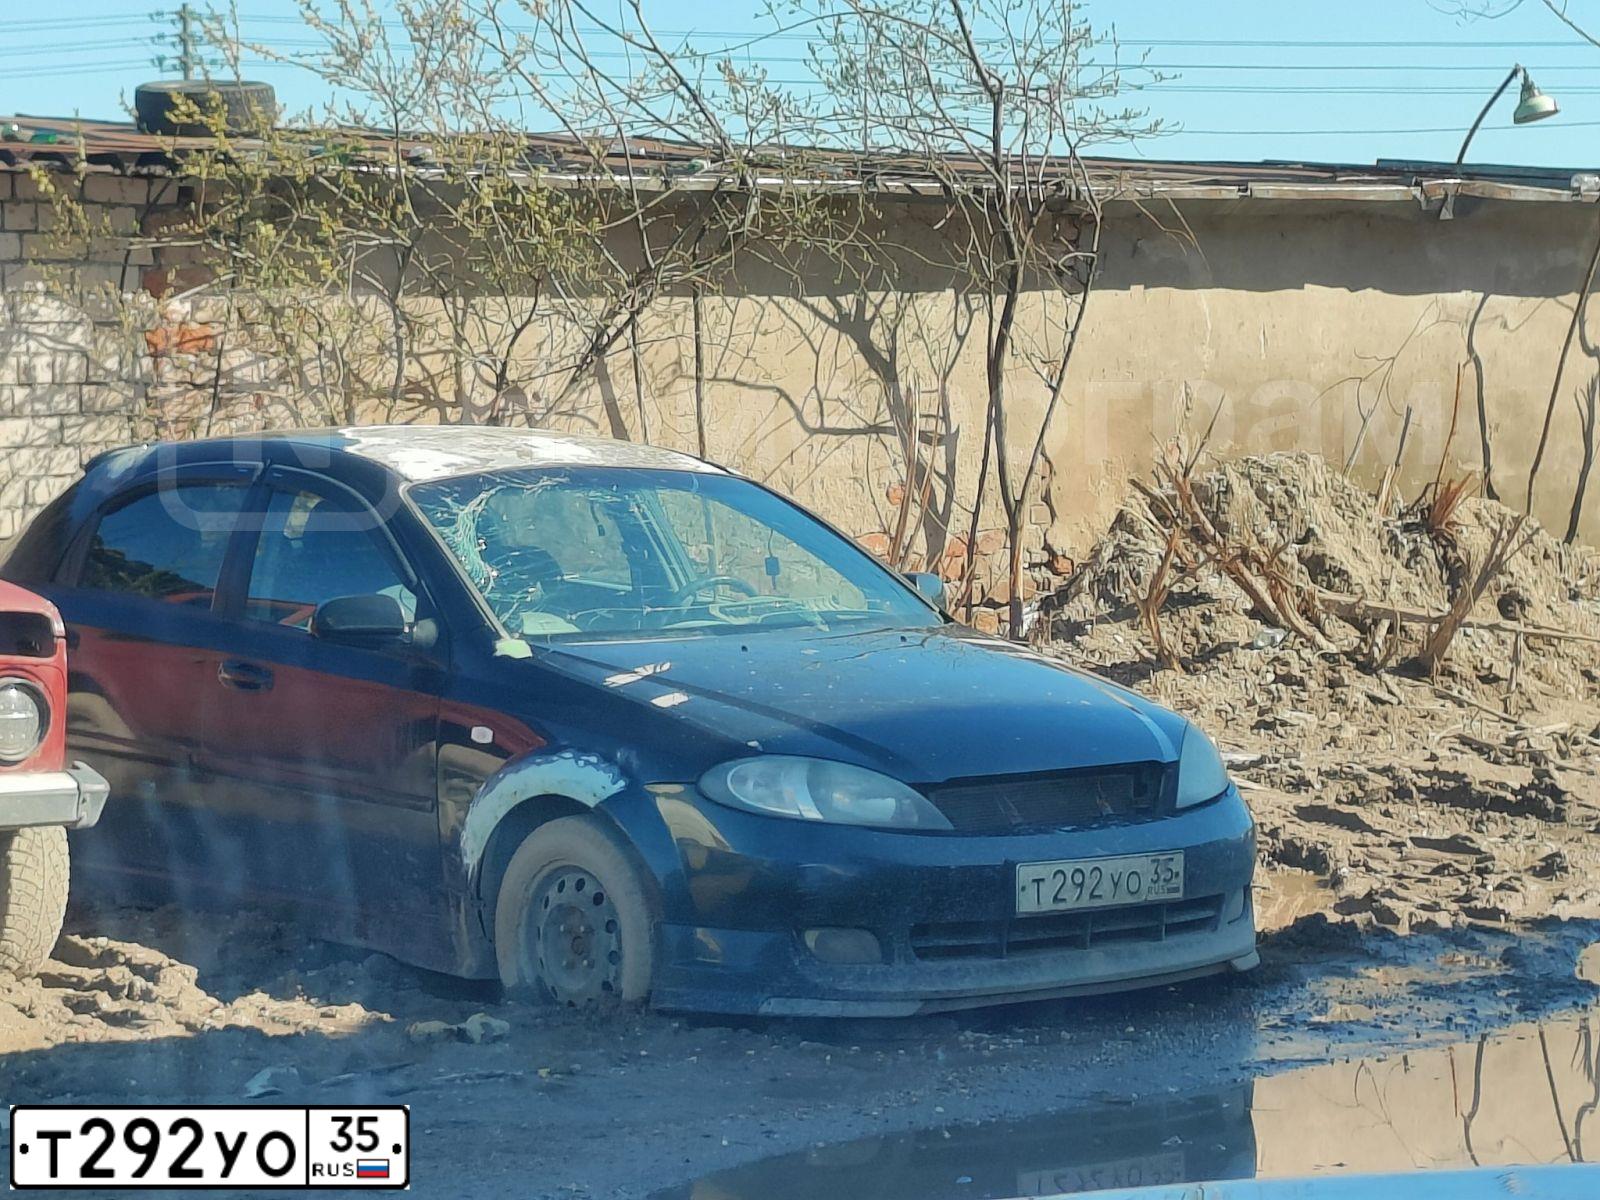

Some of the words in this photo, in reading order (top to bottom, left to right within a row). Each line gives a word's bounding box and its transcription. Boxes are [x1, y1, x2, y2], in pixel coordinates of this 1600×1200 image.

[1149, 857, 1175, 884] 35
[1031, 866, 1142, 905] Т292УО
[1147, 885, 1167, 895] RUS
